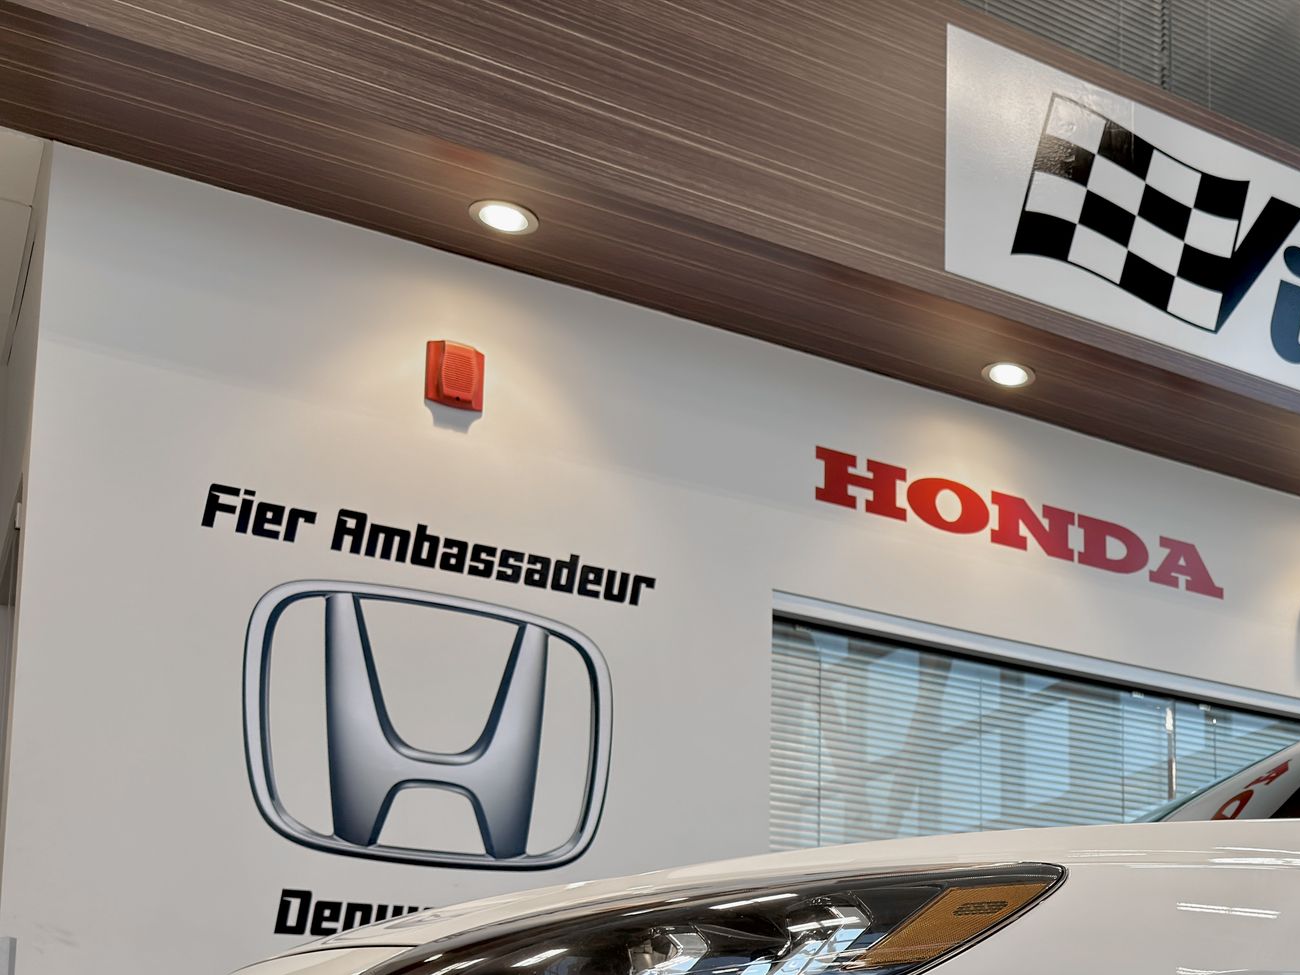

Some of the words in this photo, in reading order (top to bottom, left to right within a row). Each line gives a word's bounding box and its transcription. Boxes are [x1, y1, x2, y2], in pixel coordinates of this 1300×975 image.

[201, 483, 317, 543] Fier
[331, 508, 656, 607] Ambassadeur
[814, 445, 1224, 600] HONDA
